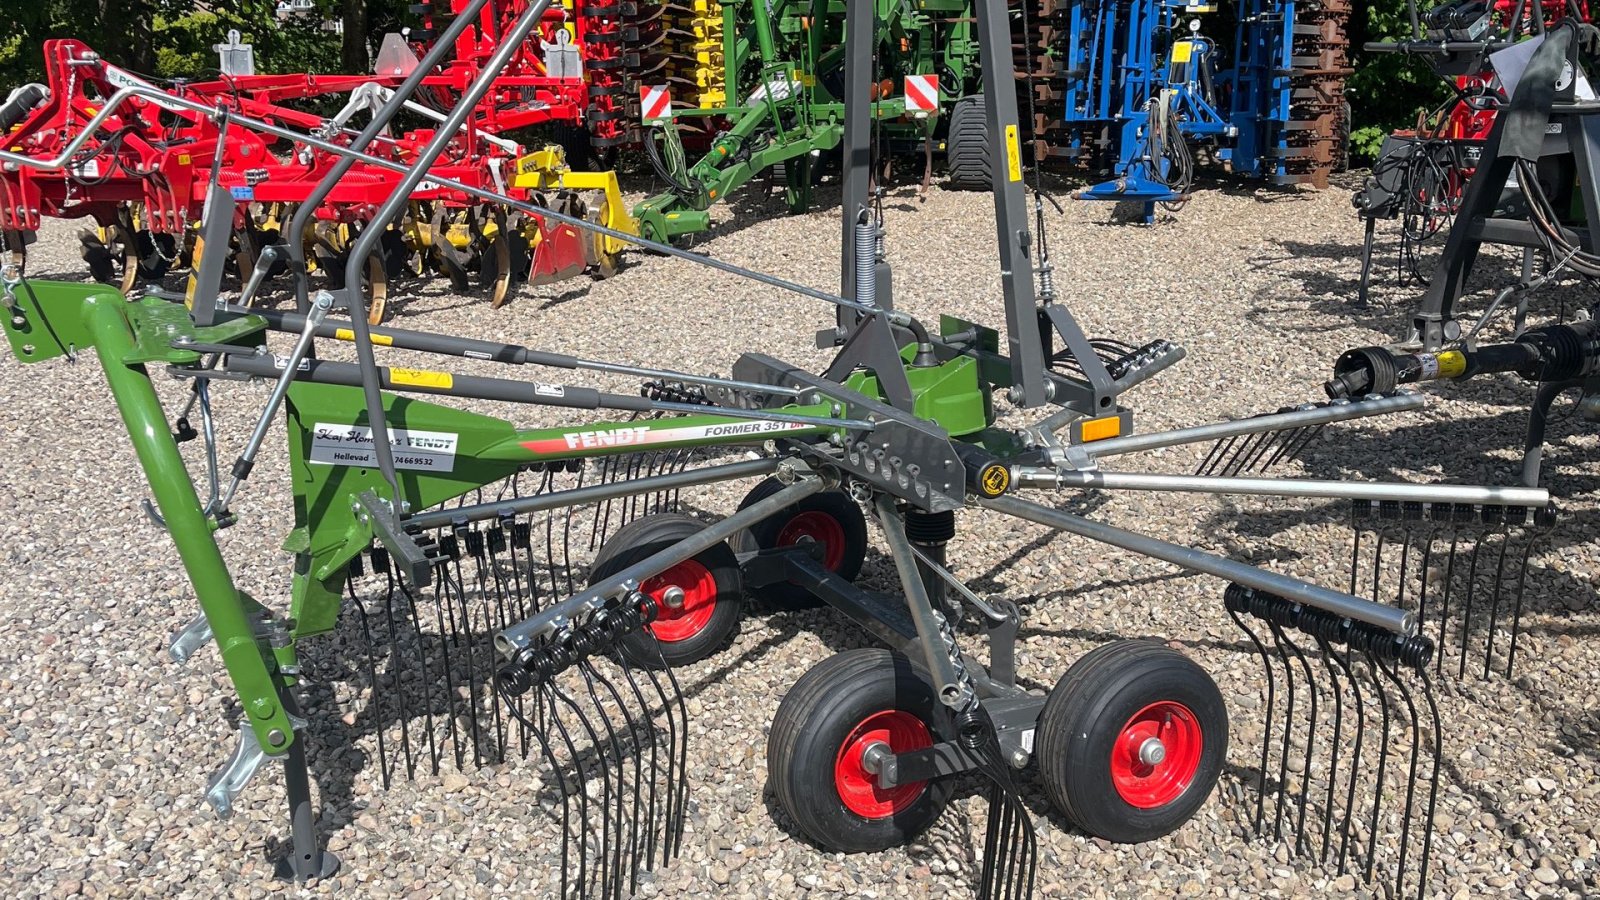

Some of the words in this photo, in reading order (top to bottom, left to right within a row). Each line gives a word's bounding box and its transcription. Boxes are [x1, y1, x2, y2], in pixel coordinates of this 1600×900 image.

[317, 429, 342, 443] Kaj
[407, 437, 454, 449] FENDT
[564, 426, 650, 449] FENDT
[705, 424, 760, 436] FORMER
[764, 421, 788, 431] 351
[334, 453, 369, 461] Hellevad
[394, 456, 433, 465] 74669532
